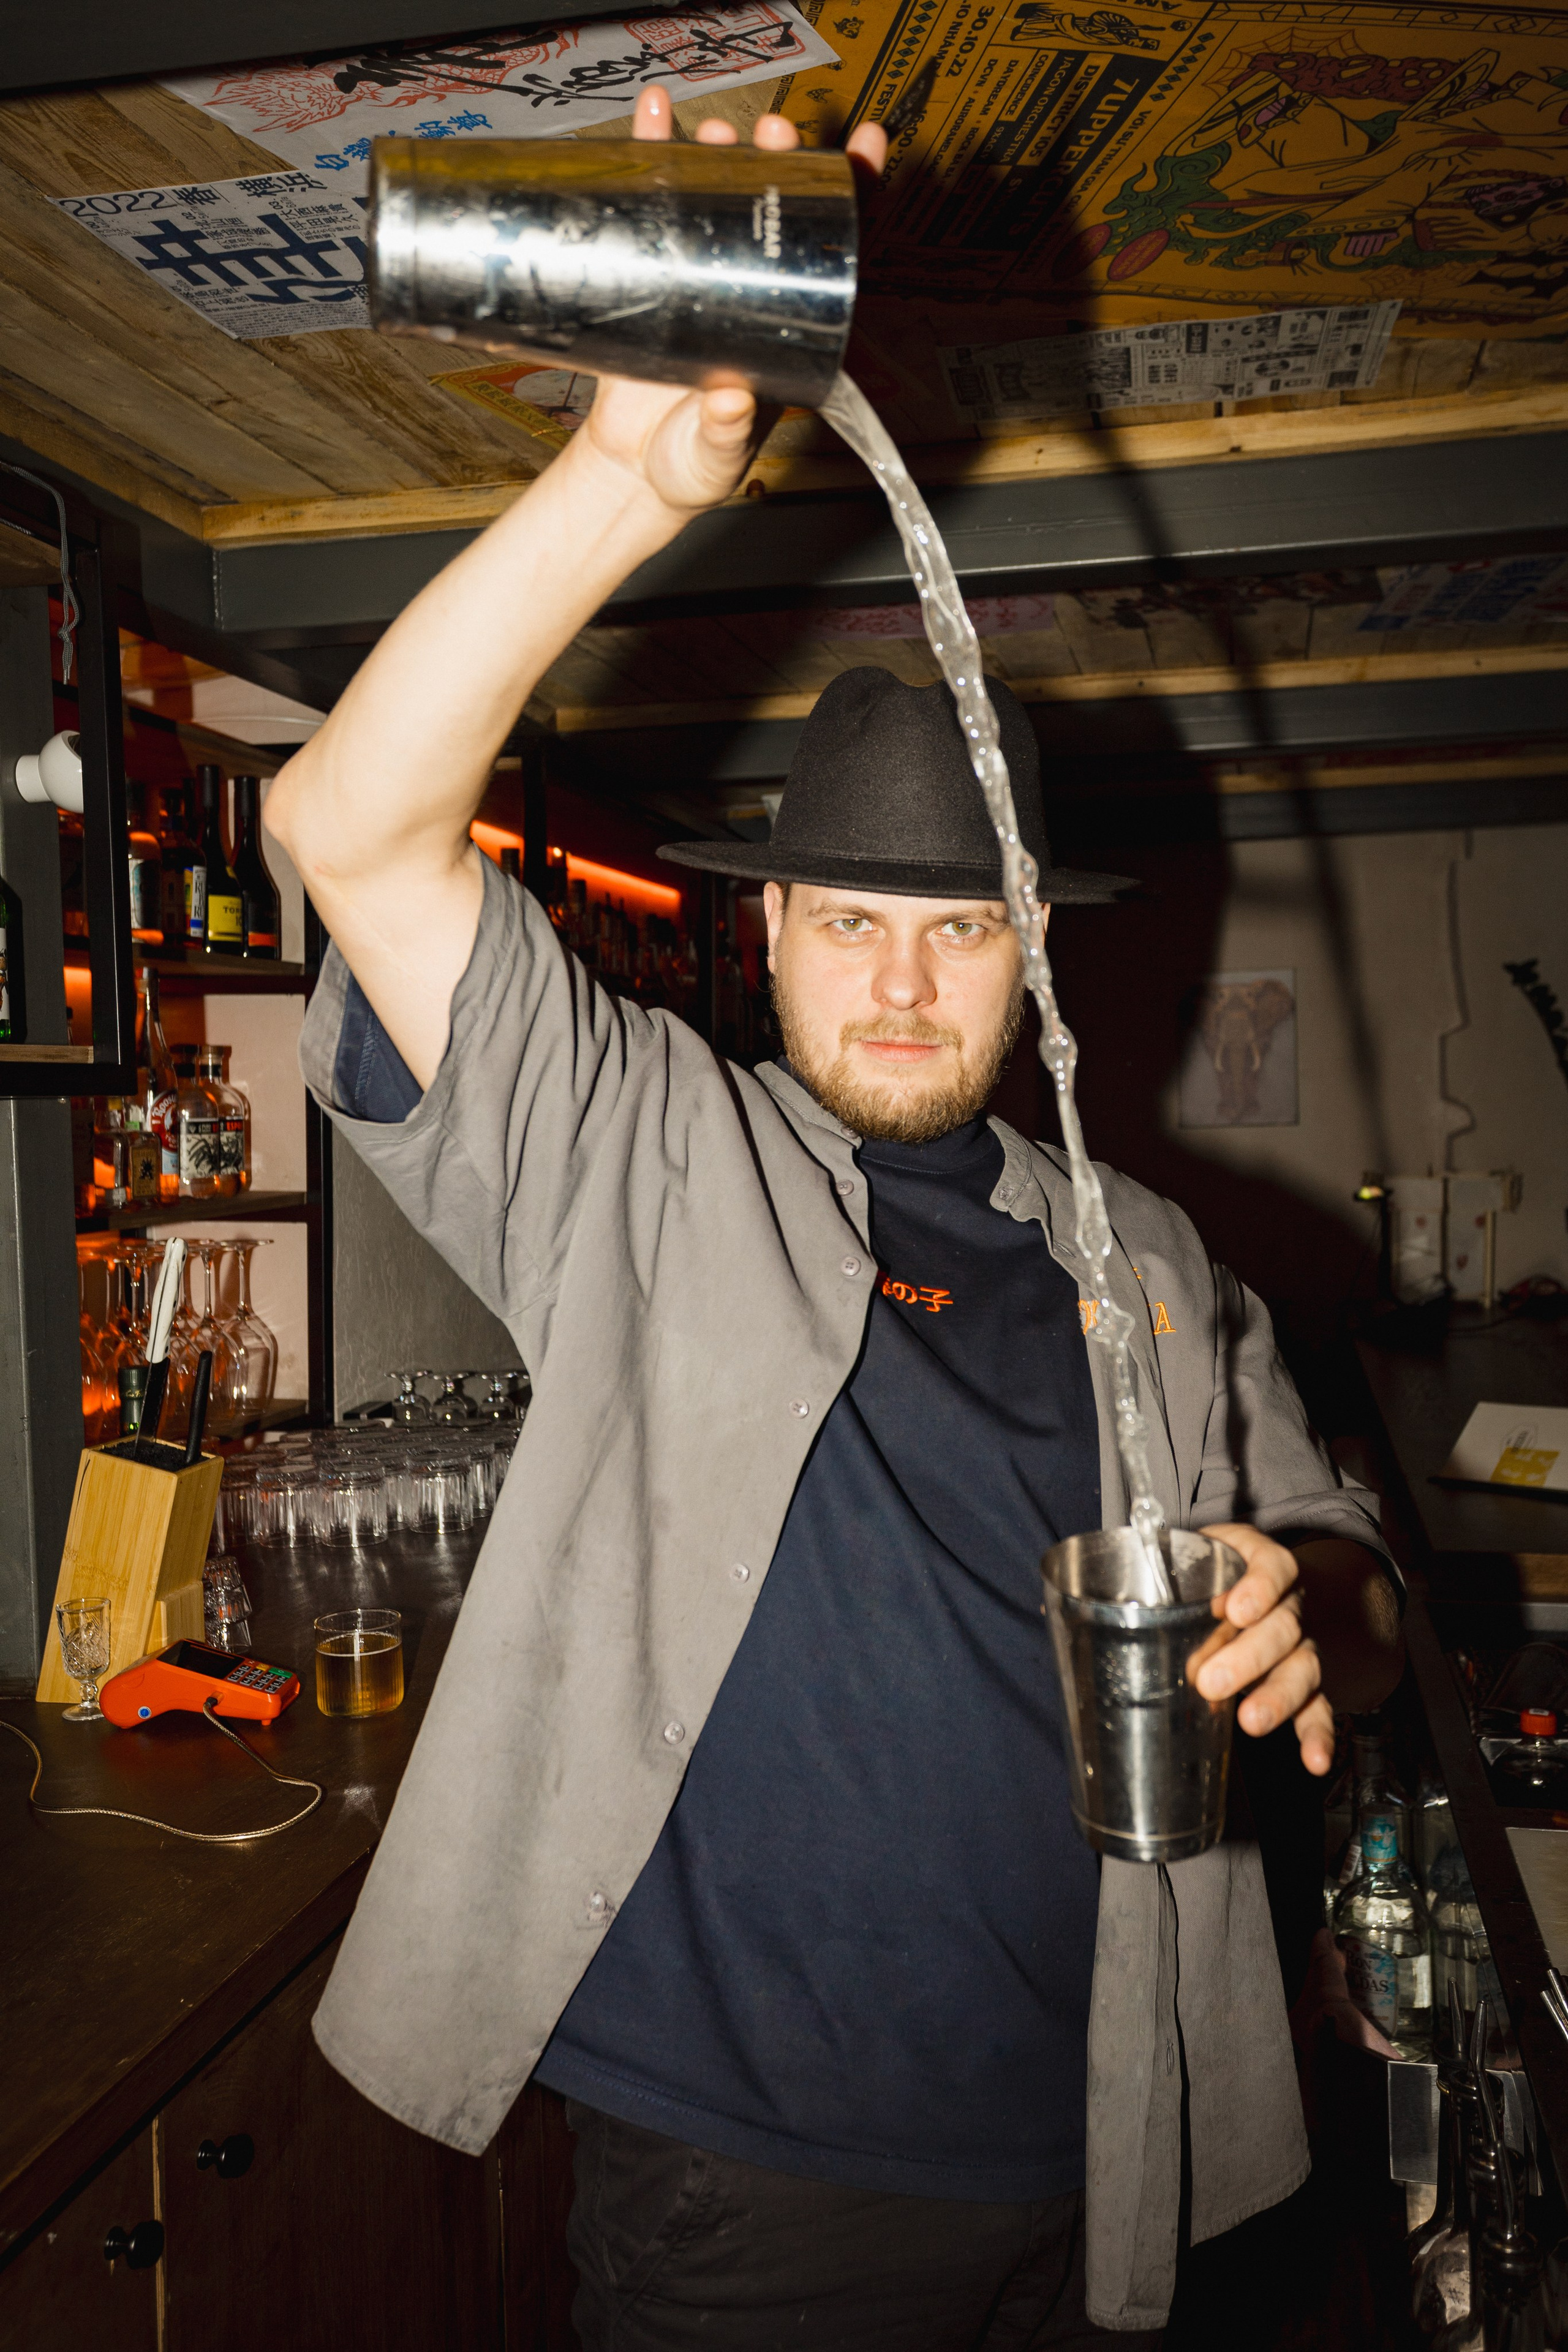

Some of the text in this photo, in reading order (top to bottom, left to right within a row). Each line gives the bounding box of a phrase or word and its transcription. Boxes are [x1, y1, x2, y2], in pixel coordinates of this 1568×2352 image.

[945, 5, 995, 78] 30.10.22
[974, 58, 998, 87] DCVN
[978, 59, 1019, 115] DAYDREAM
[1004, 53, 1049, 115] COINCIDENCE
[869, 83, 897, 122] FESTIV
[998, 55, 1076, 162] JAGON ORCHESTRA
[1027, 64, 1101, 157] DISTRICT 105
[957, 127, 979, 151] ROCK
[1005, 76, 1140, 236] 7UPPERCUTS
[1090, 148, 1121, 175] THAM
[59, 191, 178, 217] 2022
[172, 187, 221, 205] 春
